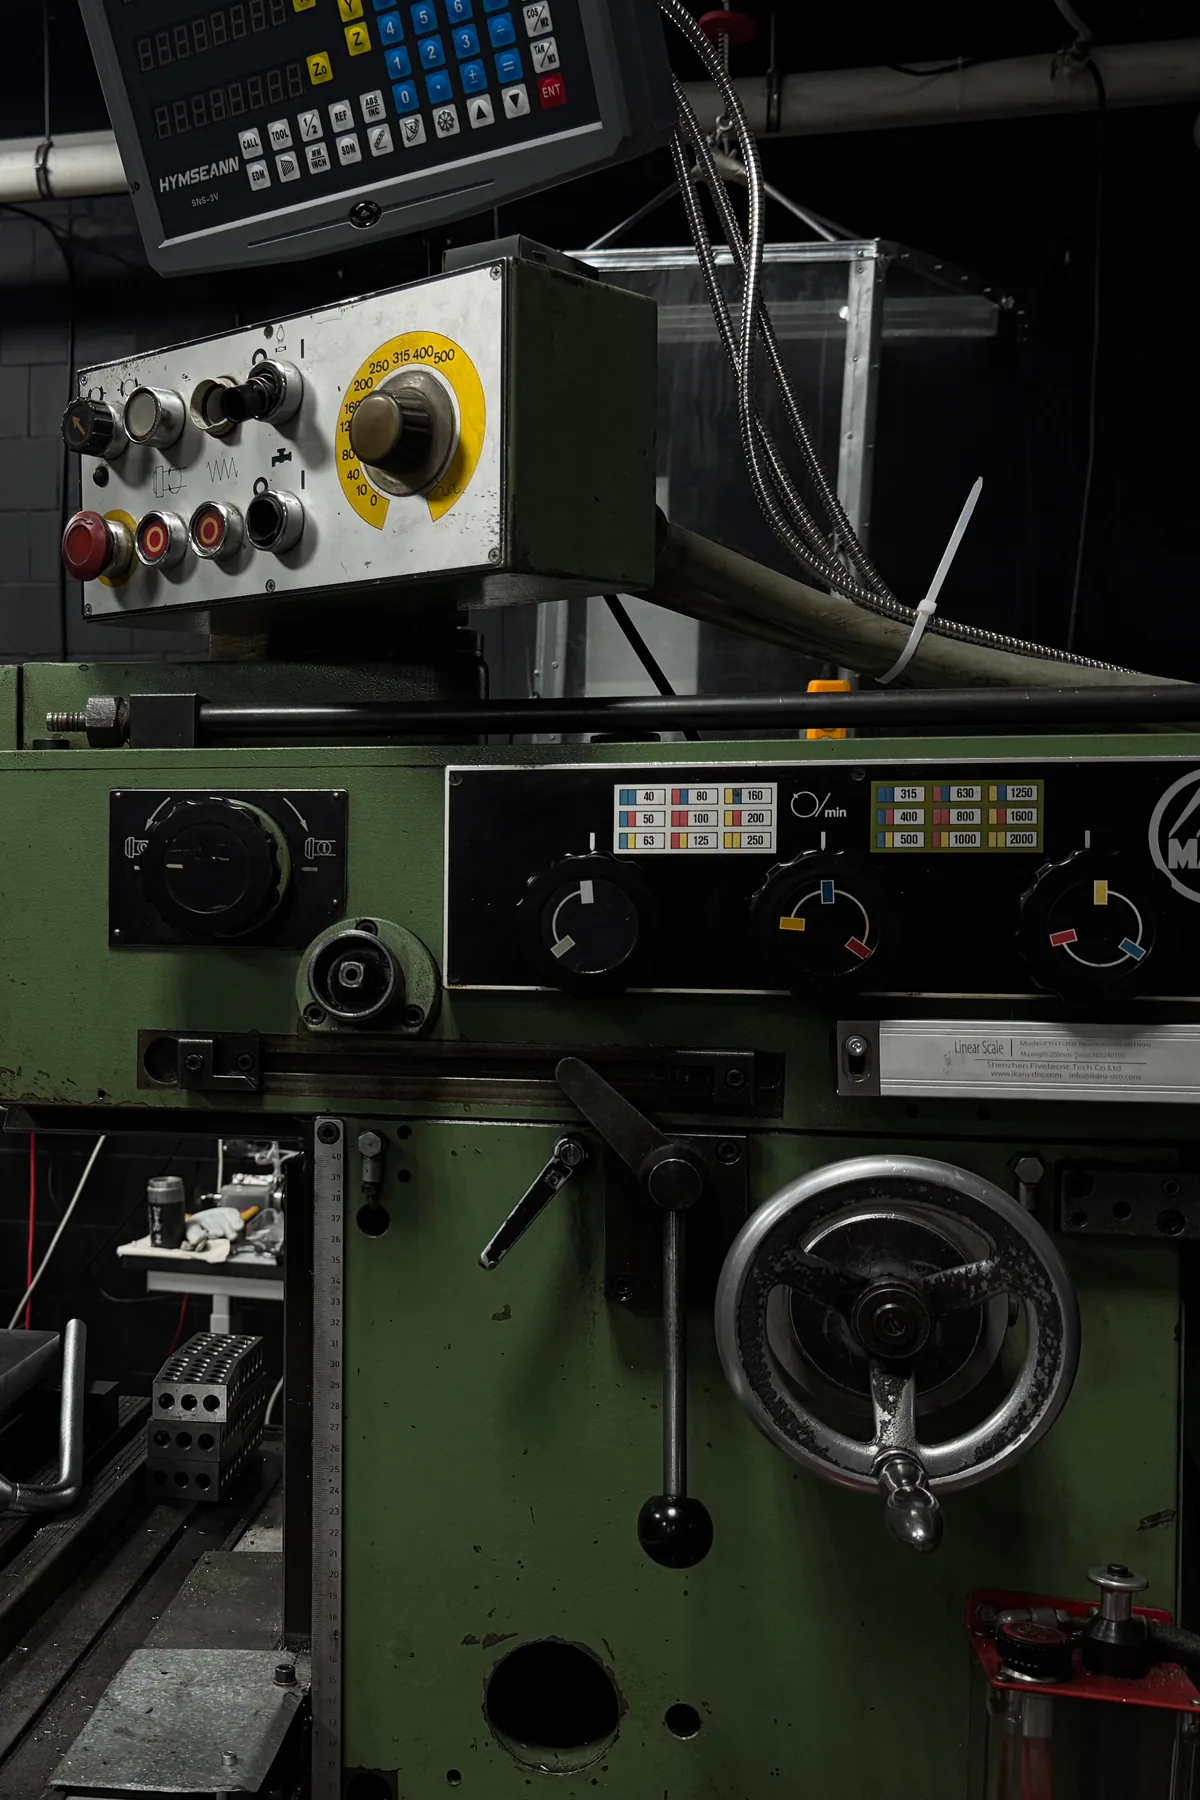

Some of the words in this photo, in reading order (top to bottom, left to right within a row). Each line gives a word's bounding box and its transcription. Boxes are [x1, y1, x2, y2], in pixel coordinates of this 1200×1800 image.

[454, 0, 463, 13] 6
[419, 10, 428, 25] 5
[386, 21, 395, 35] 4
[353, 33, 363, 47] Z
[461, 34, 471, 49] 3
[426, 46, 436, 60] 2
[393, 56, 402, 70] 1
[541, 83, 561, 98] ENT
[365, 95, 379, 107] ABS
[401, 90, 409, 104] 0
[334, 110, 347, 123] REF
[368, 106, 380, 117] INC
[271, 129, 289, 141] TOOL
[243, 137, 259, 150] CALL
[341, 143, 356, 155] SDM
[312, 148, 321, 157] MM
[311, 159, 327, 169] INCH
[159, 156, 239, 193] HYMSEANN
[252, 169, 266, 181] EDM
[191, 192, 219, 207] SNS-3V
[393, 350, 410, 364] 315
[413, 345, 434, 359] 400
[434, 349, 455, 363] 500
[369, 360, 389, 374] 250
[354, 377, 373, 391] 200
[340, 421, 351, 432] 12
[342, 450, 355, 461] 80
[347, 469, 359, 480] 40
[356, 484, 367, 496] 10
[370, 495, 378, 506] 0
[644, 791, 654, 801] 40
[696, 791, 707, 801] 80
[748, 790, 763, 800] 160
[900, 789, 917, 799] 315
[956, 788, 974, 798] 630
[1011, 787, 1033, 798] 1250
[643, 814, 654, 824] 50
[694, 814, 709, 823] 100
[747, 813, 764, 823] 200
[900, 812, 918, 822] 400
[956, 811, 974, 822] 800
[1011, 811, 1033, 821] 1600
[643, 836, 654, 846] 63
[694, 836, 709, 845] 125
[747, 835, 764, 845] 250
[900, 834, 918, 844] 500
[954, 834, 976, 844] 1000
[1010, 834, 1033, 844] 2000
[1168, 838, 1200, 869] M
[954, 1040, 980, 1054] Linear
[982, 1040, 1004, 1055] Scale
[331, 1256, 341, 1264] 35
[329, 1655, 337, 1663] 16
